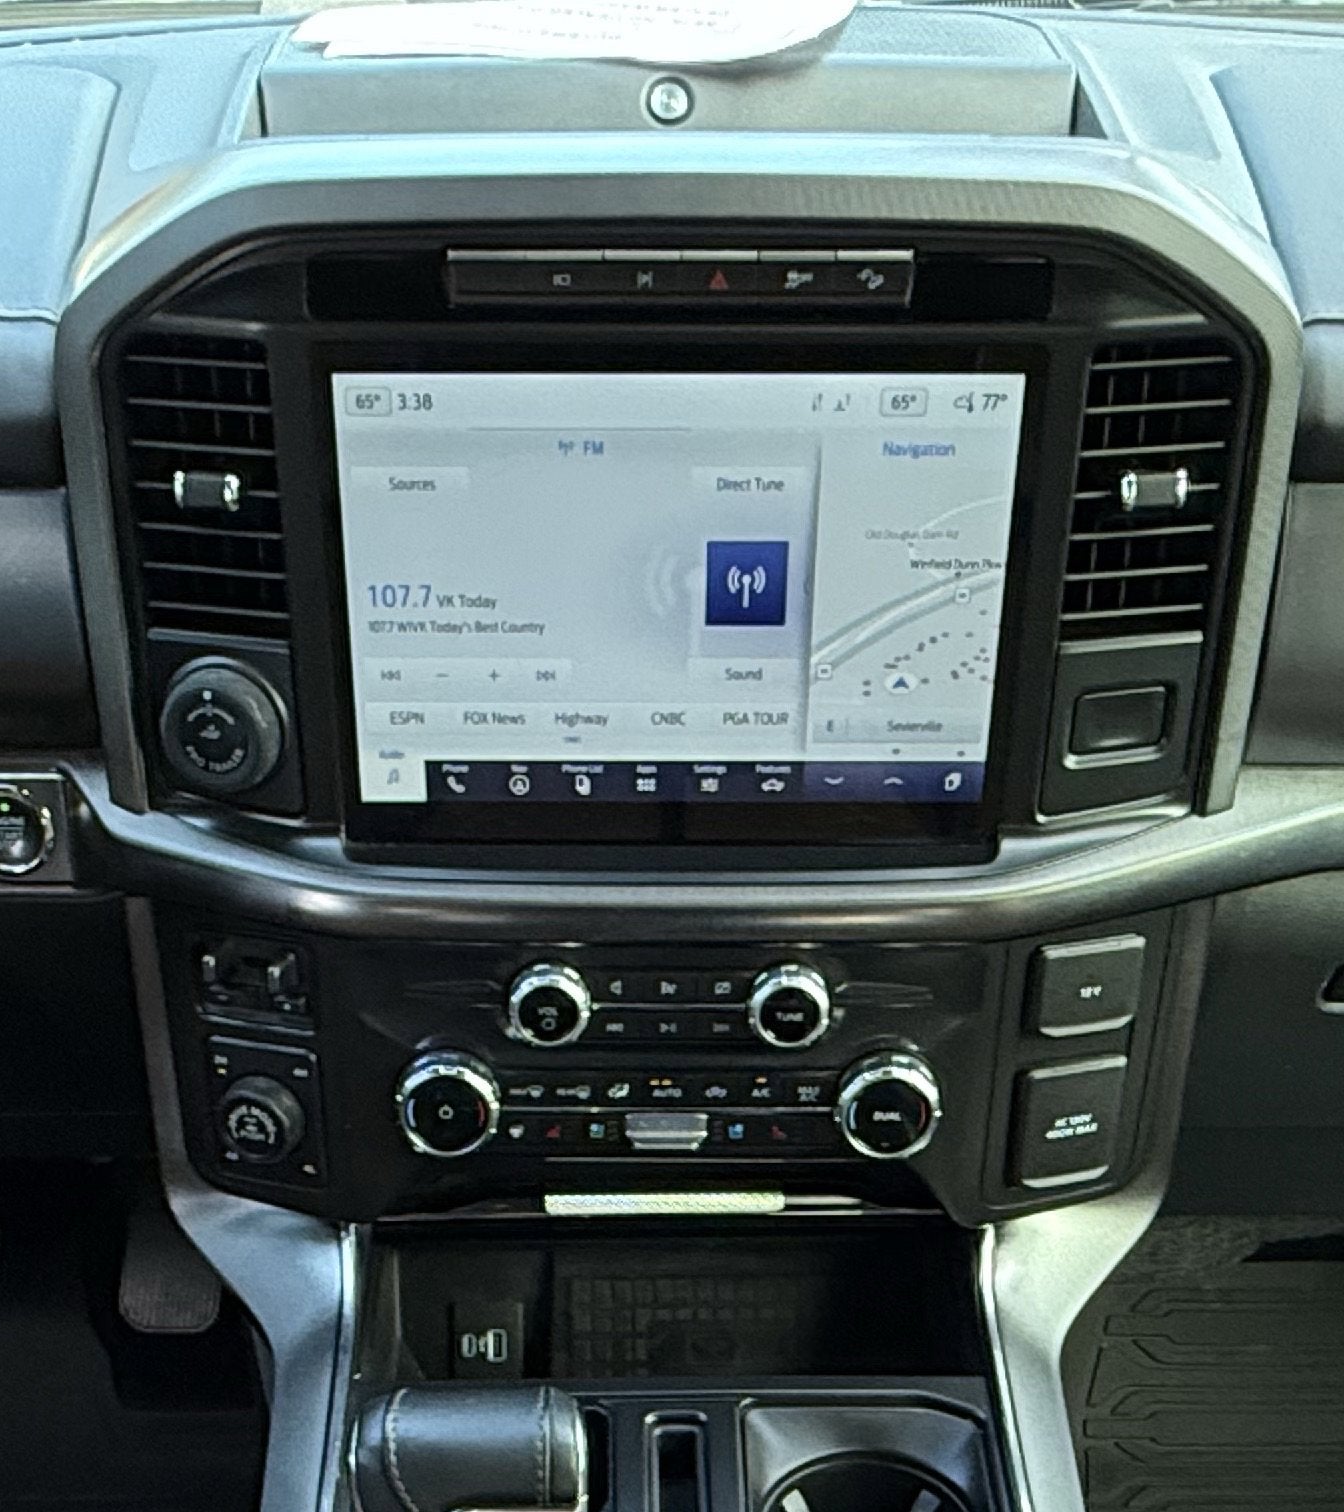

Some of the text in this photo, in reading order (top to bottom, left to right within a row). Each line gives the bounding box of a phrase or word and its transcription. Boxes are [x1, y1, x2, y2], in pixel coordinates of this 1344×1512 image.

[582, 440, 605, 456] FM
[882, 440, 957, 460] Navigation
[388, 476, 437, 492] Sources
[716, 476, 785, 492] Direct Tune
[367, 584, 499, 611] 107.7 VK Today
[430, 620, 473, 636] Today's
[473, 620, 500, 634] Best
[500, 620, 546, 637] Country
[724, 666, 764, 682] Sound
[389, 710, 426, 726] ESPN
[462, 710, 527, 726] FOX News
[554, 710, 609, 729] Highway
[650, 711, 688, 727] CNBC
[723, 711, 790, 726] PGA TOUR
